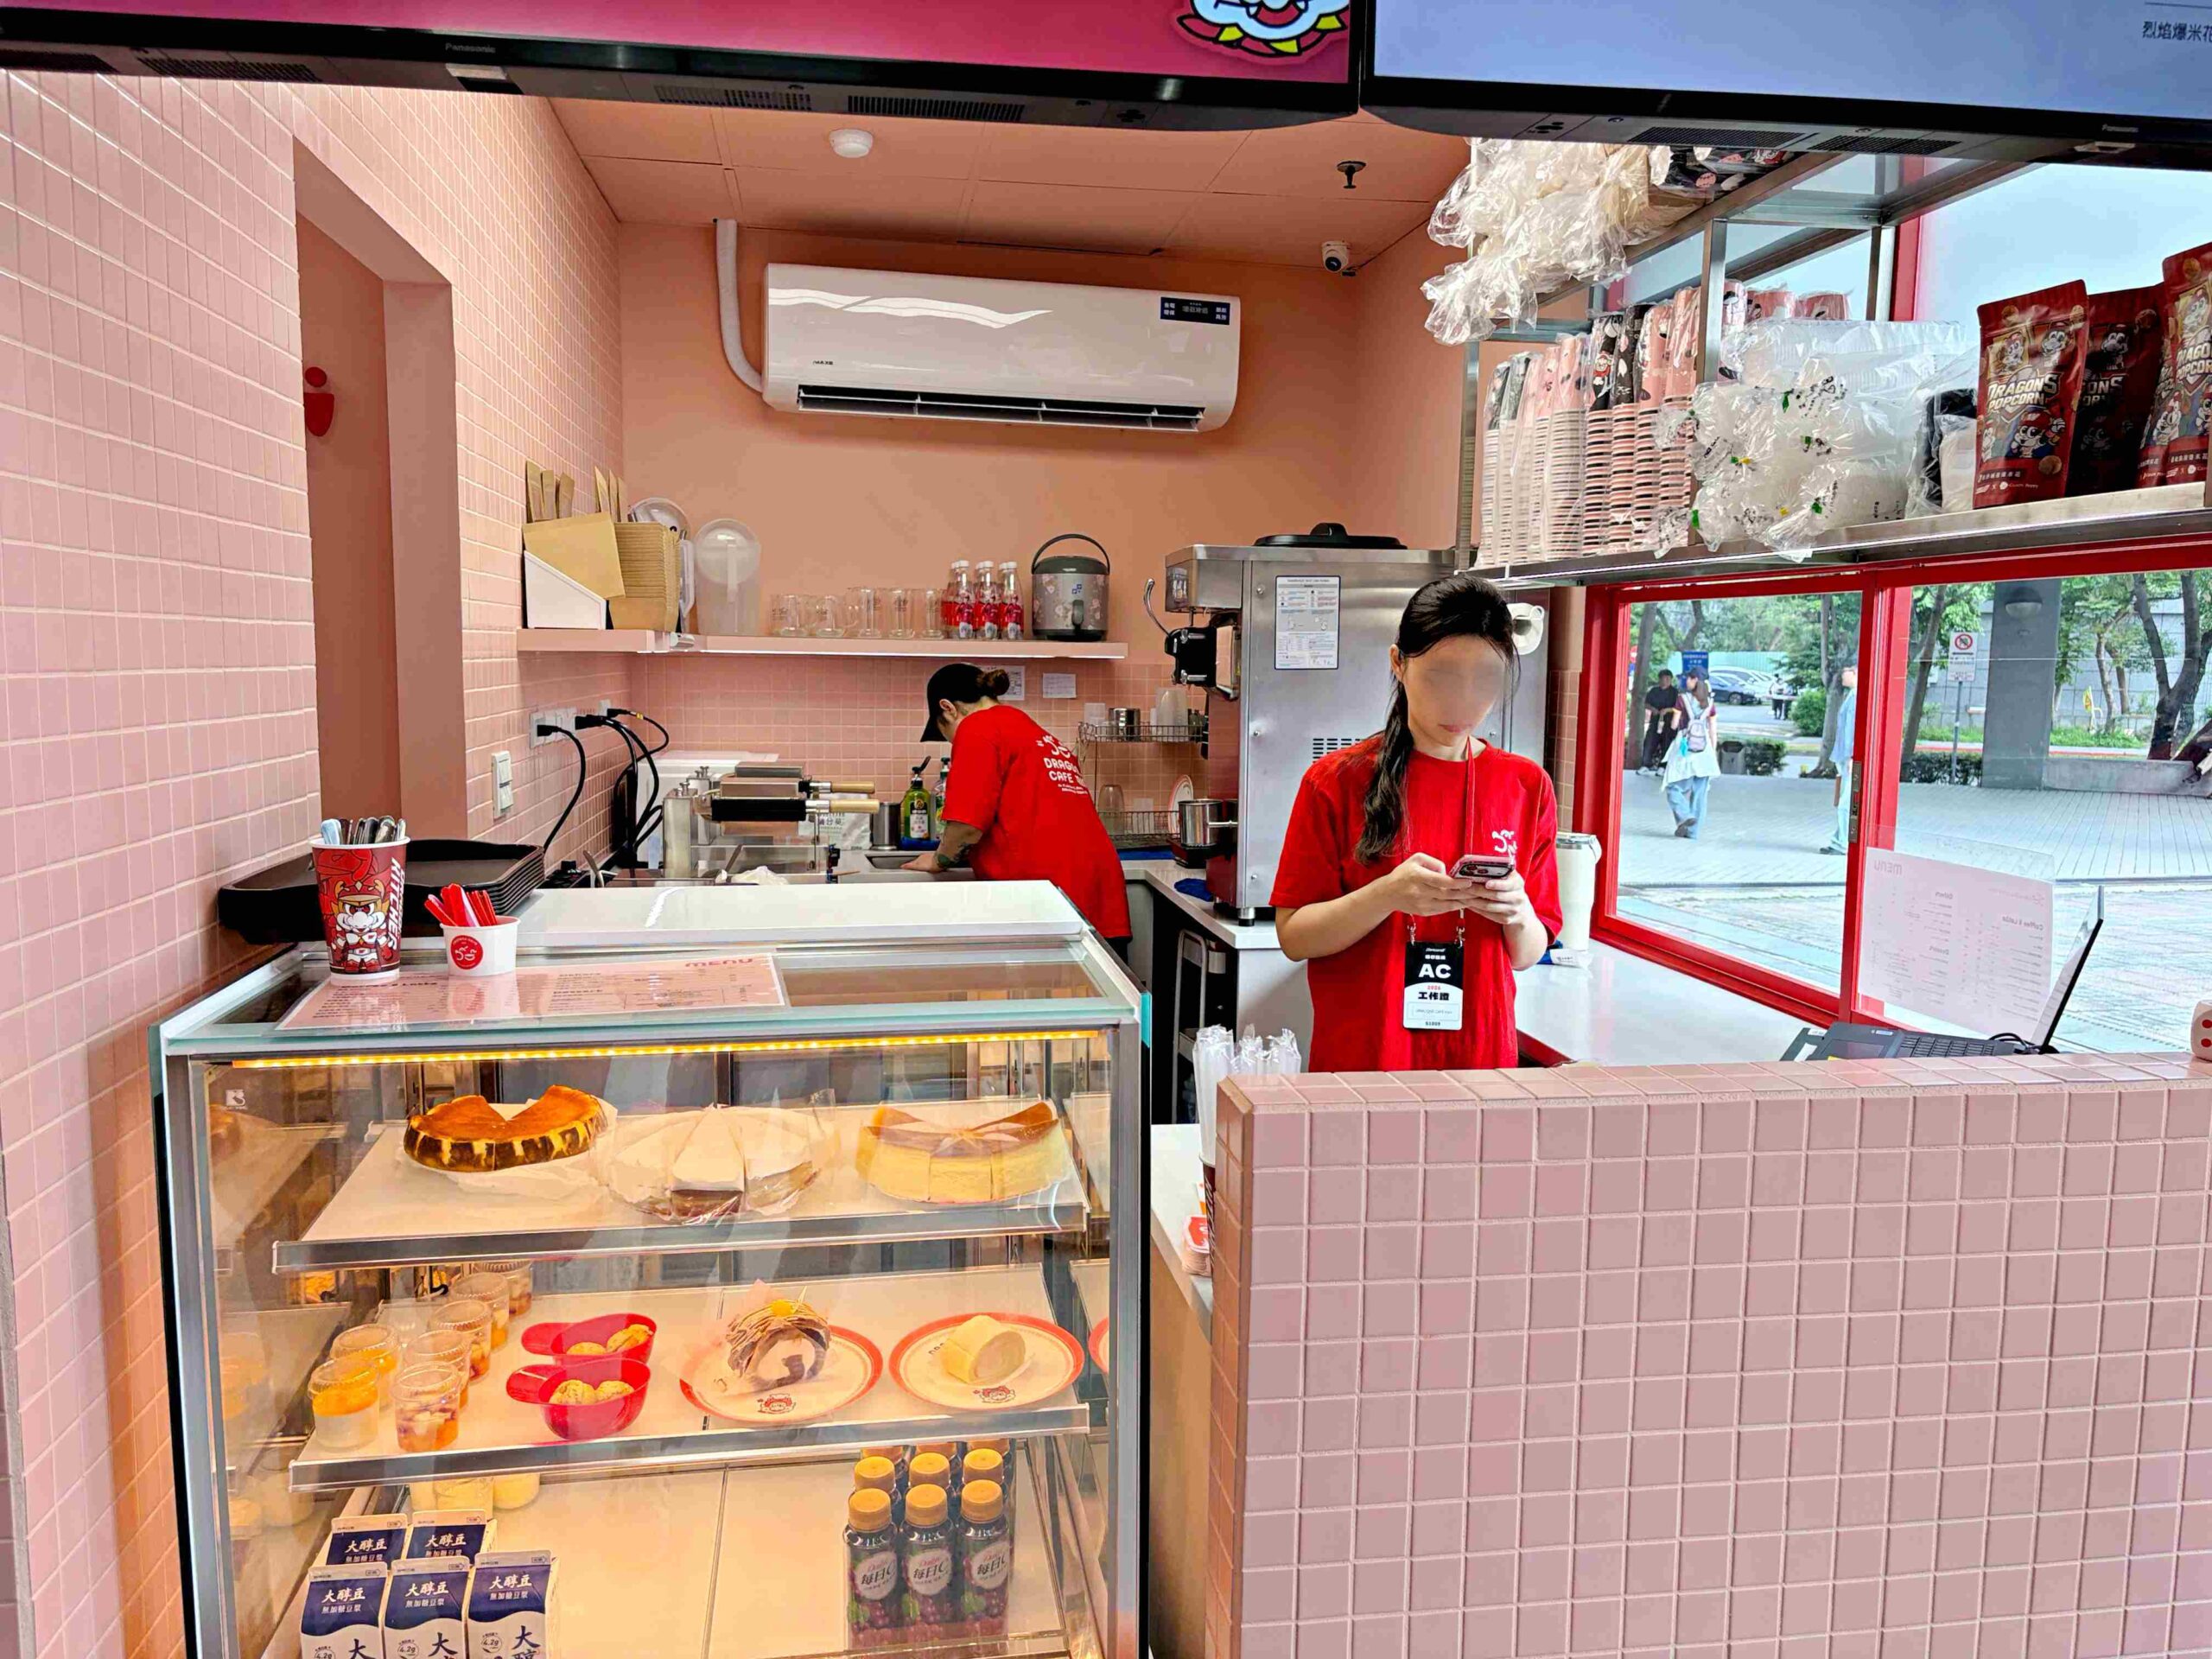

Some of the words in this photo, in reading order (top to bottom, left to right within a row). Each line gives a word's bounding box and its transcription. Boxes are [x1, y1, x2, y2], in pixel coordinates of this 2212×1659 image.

[1987, 372, 2059, 401] DRAGONS
[1988, 392, 2045, 414] POPCORN
[1048, 770, 1074, 784] CAFE
[1418, 963, 1452, 979] AC
[345, 1538, 388, 1554] 大醇豆
[424, 1533, 467, 1548] 大醇豆
[405, 1580, 449, 1598] 大醇豆
[489, 1574, 532, 1590] 大醇豆
[321, 1587, 365, 1604] 大醇豆
[429, 1631, 458, 1659] 大
